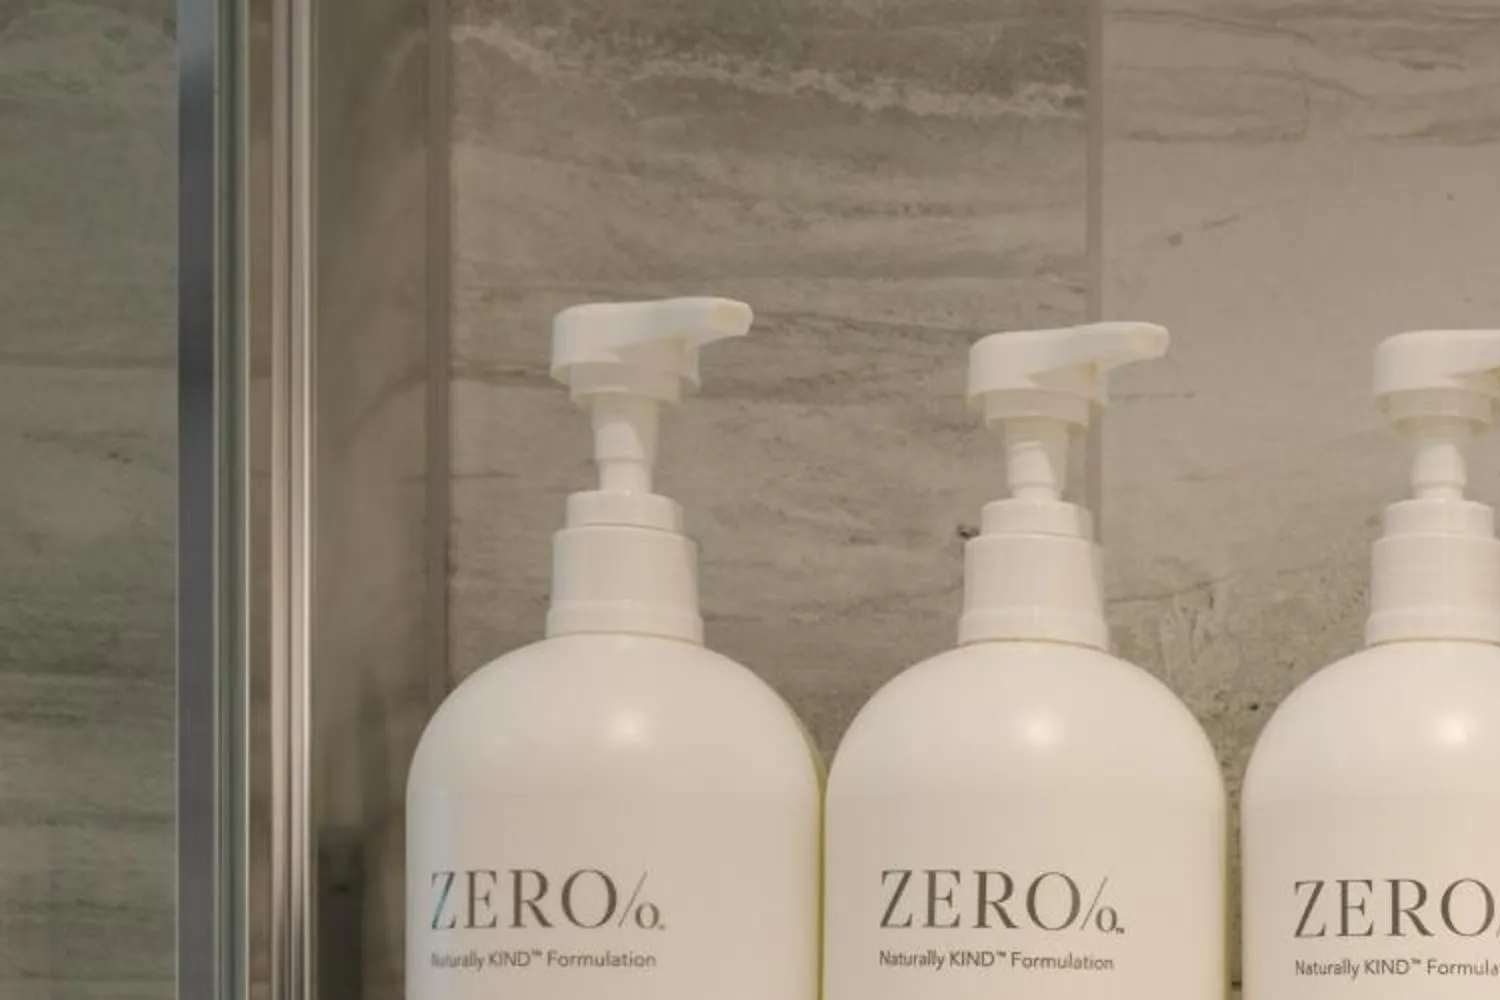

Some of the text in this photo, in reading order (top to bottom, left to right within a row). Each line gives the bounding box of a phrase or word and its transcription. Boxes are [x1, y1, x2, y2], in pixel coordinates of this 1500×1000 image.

[547, 951, 656, 968] Formulation
[879, 950, 944, 971] Naturally
[1011, 952, 1114, 970] Formulation
[1295, 959, 1359, 979] Naturally
